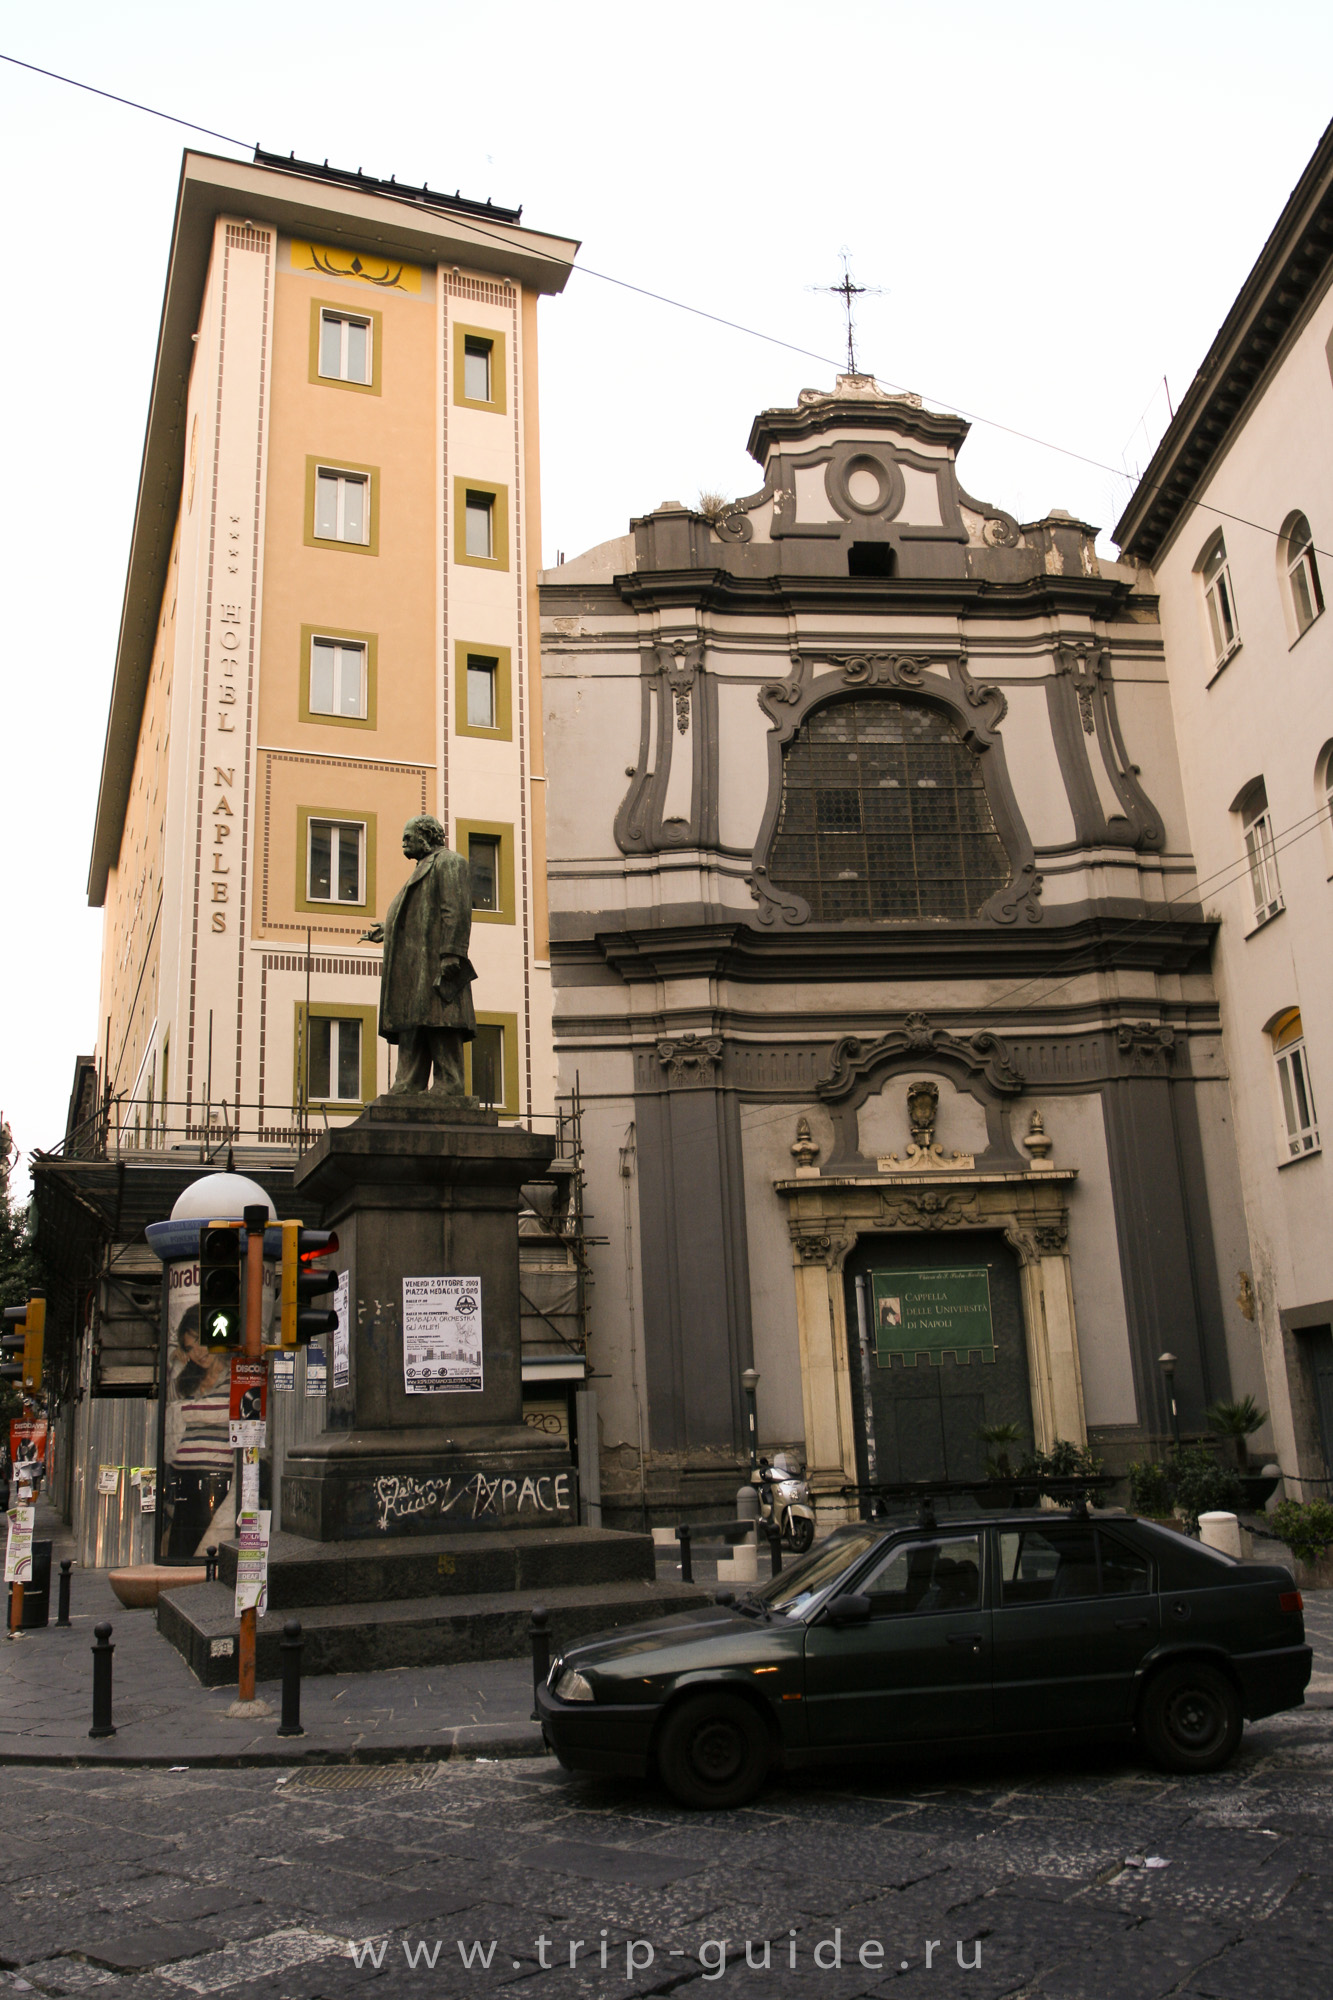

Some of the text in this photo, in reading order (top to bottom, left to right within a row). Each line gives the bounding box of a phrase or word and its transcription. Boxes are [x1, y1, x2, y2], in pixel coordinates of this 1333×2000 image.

[211, 604, 241, 933] HOTEL NAPLES
[437, 1279, 463, 1287] OTTOBRE
[430, 1287, 459, 1295] MEDAGLIE
